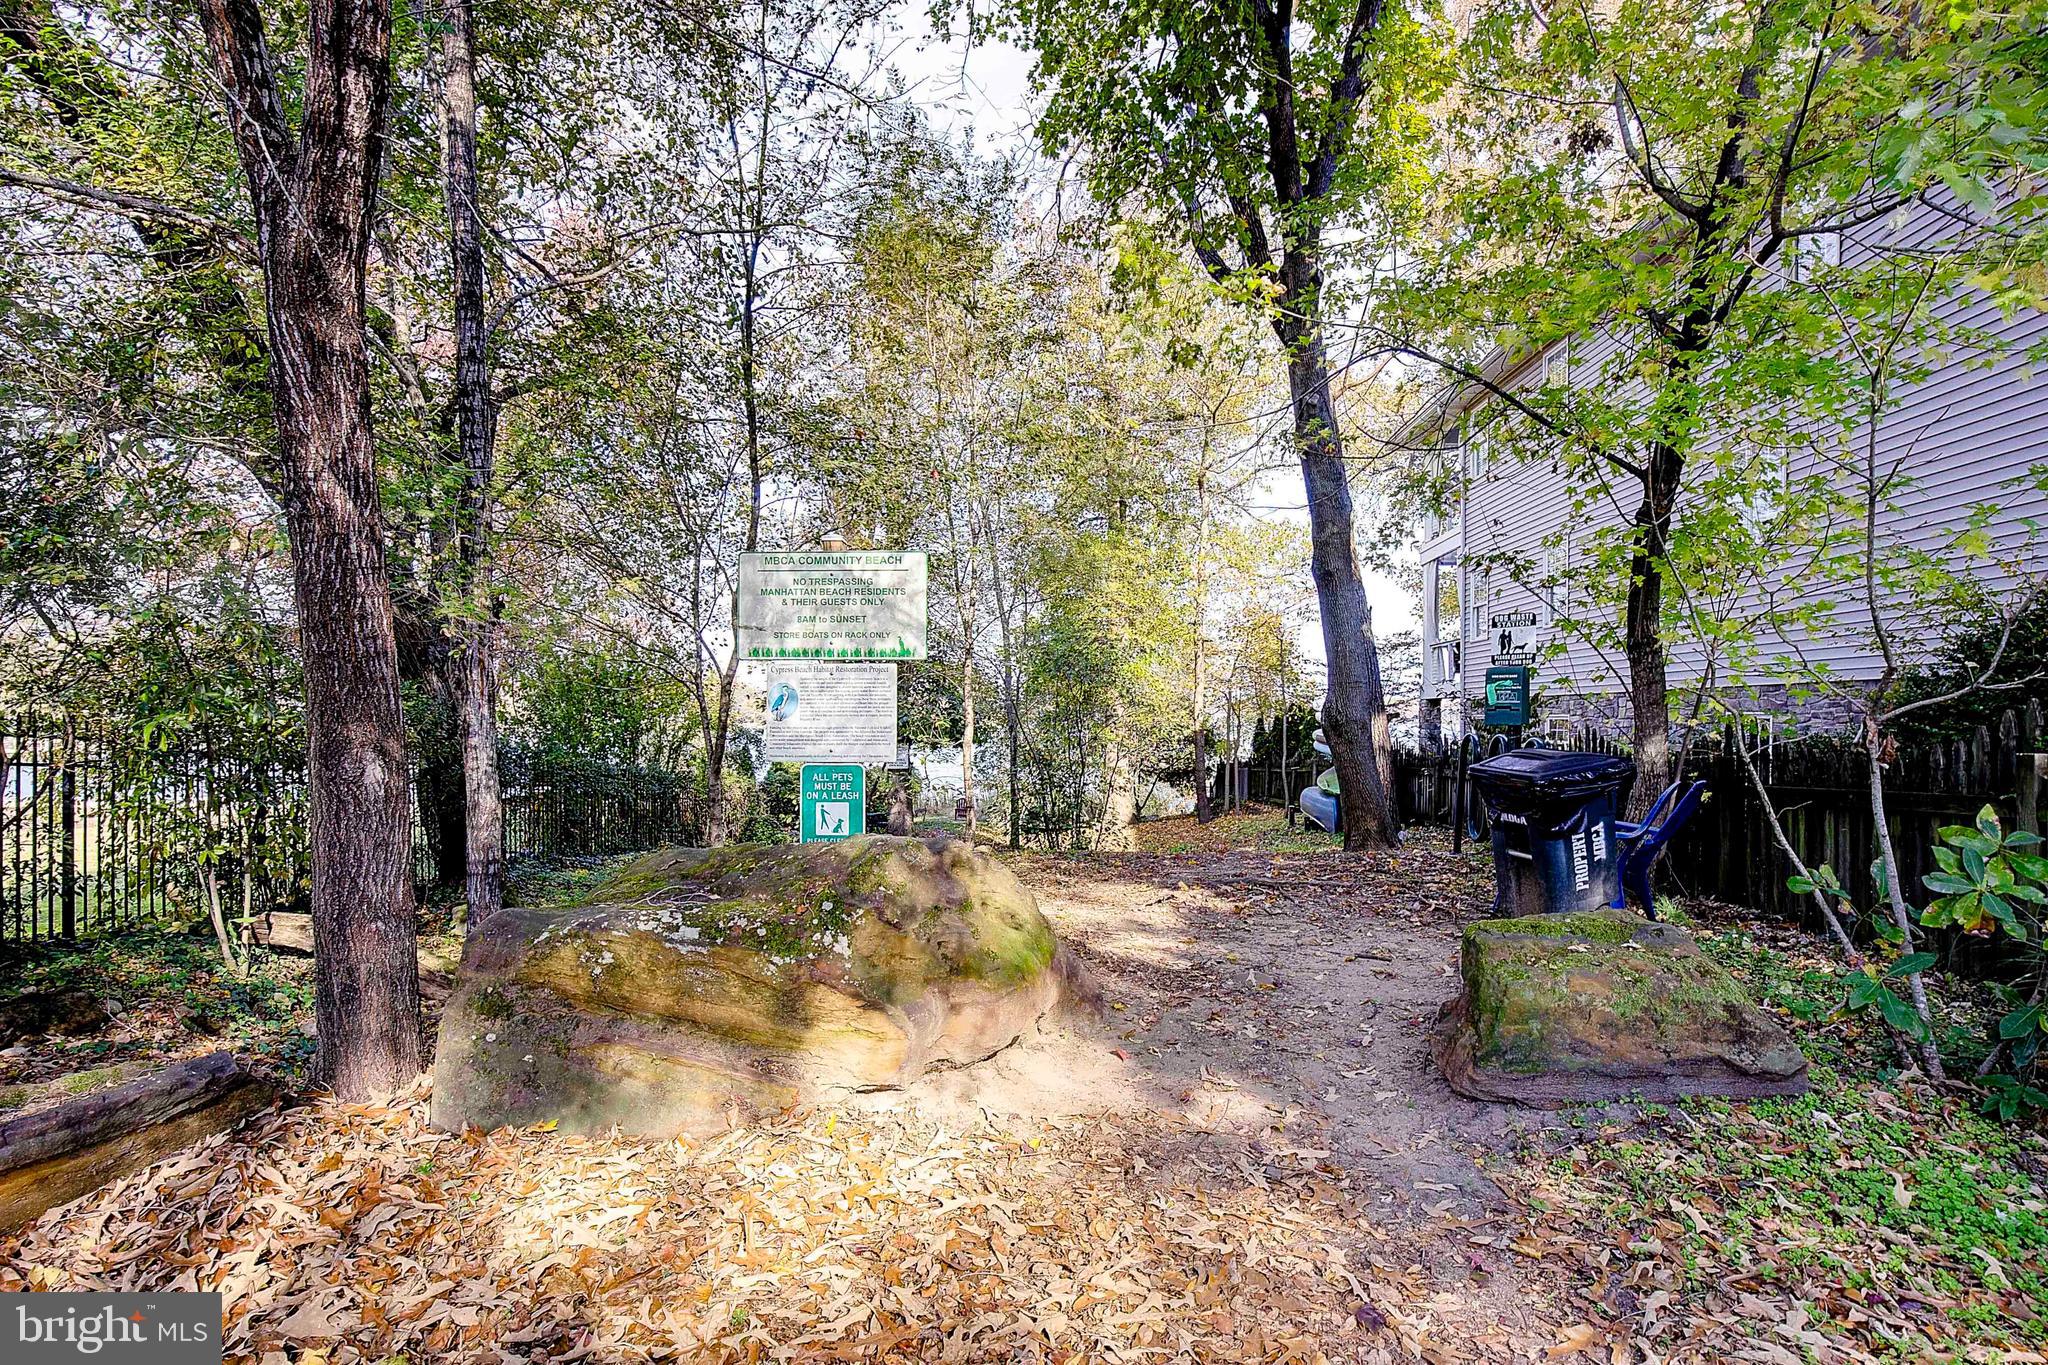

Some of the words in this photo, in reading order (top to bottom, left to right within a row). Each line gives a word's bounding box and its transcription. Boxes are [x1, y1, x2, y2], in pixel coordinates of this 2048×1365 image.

[764, 556, 796, 565] MBCA
[798, 556, 861, 565] COMMUNITY
[865, 556, 902, 565] BEACH
[792, 577, 807, 586] NO
[809, 577, 873, 586] TRESPASSING
[760, 588, 817, 596] MANHATTAN
[819, 588, 852, 596] BEACH
[854, 588, 906, 596] RESIDENTS
[781, 598, 788, 606] &
[791, 598, 818, 606] THEIR
[820, 598, 857, 606] GUESTS
[860, 598, 885, 606] ONLY
[797, 615, 816, 623] 8AM
[829, 615, 867, 623] SUNSET
[1496, 620, 1531, 628] STATION
[773, 631, 800, 639] STORE
[802, 631, 829, 639] BOATS
[869, 631, 890, 639] ONLY
[770, 665, 794, 675] Cypress
[795, 665, 812, 673] Beach
[813, 665, 834, 673] Habitat
[835, 665, 867, 673] Restoration
[868, 665, 889, 674] Project
[812, 773, 829, 781] ALL
[832, 773, 853, 781] PETS
[814, 782, 836, 790] MUST
[840, 782, 851, 790] BE
[806, 791, 819, 800] ON
[822, 791, 829, 800] A
[831, 791, 860, 800] LEASH
[1591, 821, 1607, 862] MBCA
[1571, 832, 1590, 892] PROPERT
